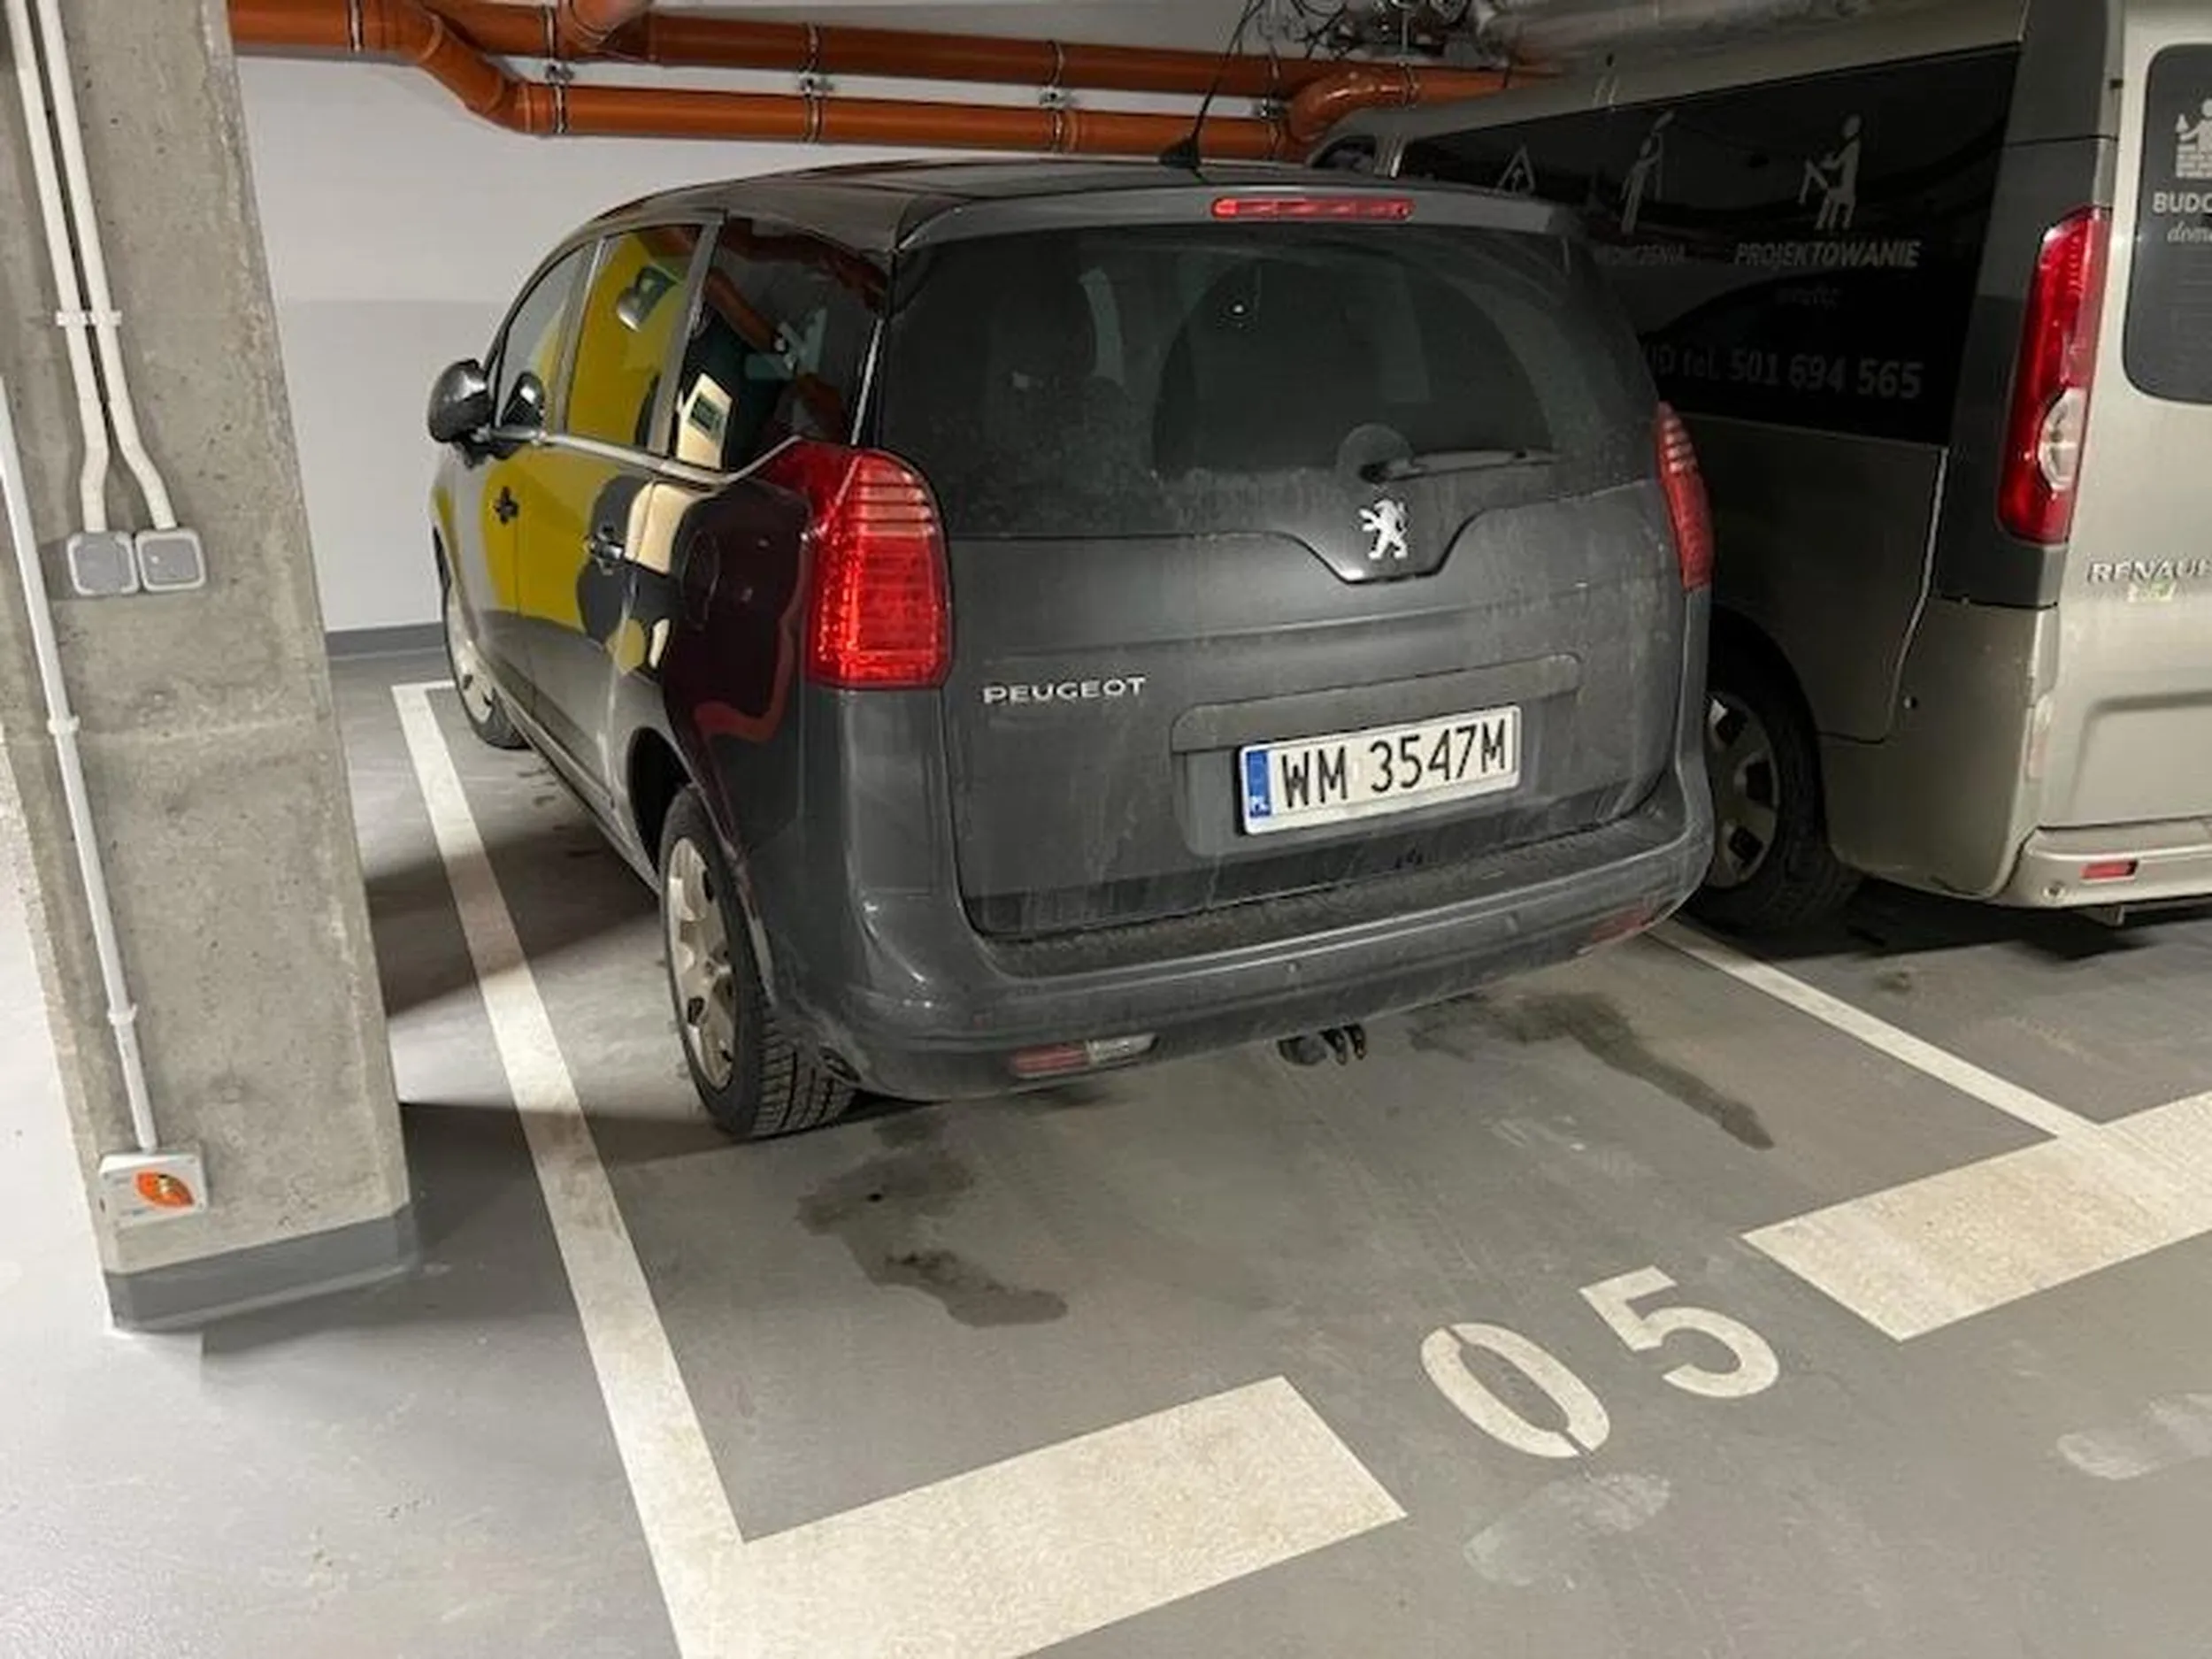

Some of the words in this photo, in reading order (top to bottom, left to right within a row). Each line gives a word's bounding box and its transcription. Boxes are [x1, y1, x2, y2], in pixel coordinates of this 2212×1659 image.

[1734, 241, 1922, 267] PROJEKTOWANIE
[1729, 346, 1779, 386] 501
[1787, 353, 1847, 394] 694
[1856, 357, 1925, 399] 565
[982, 676, 1148, 705] PEUGEOT
[1280, 745, 1348, 809] WM
[1370, 718, 1506, 794] 3547M
